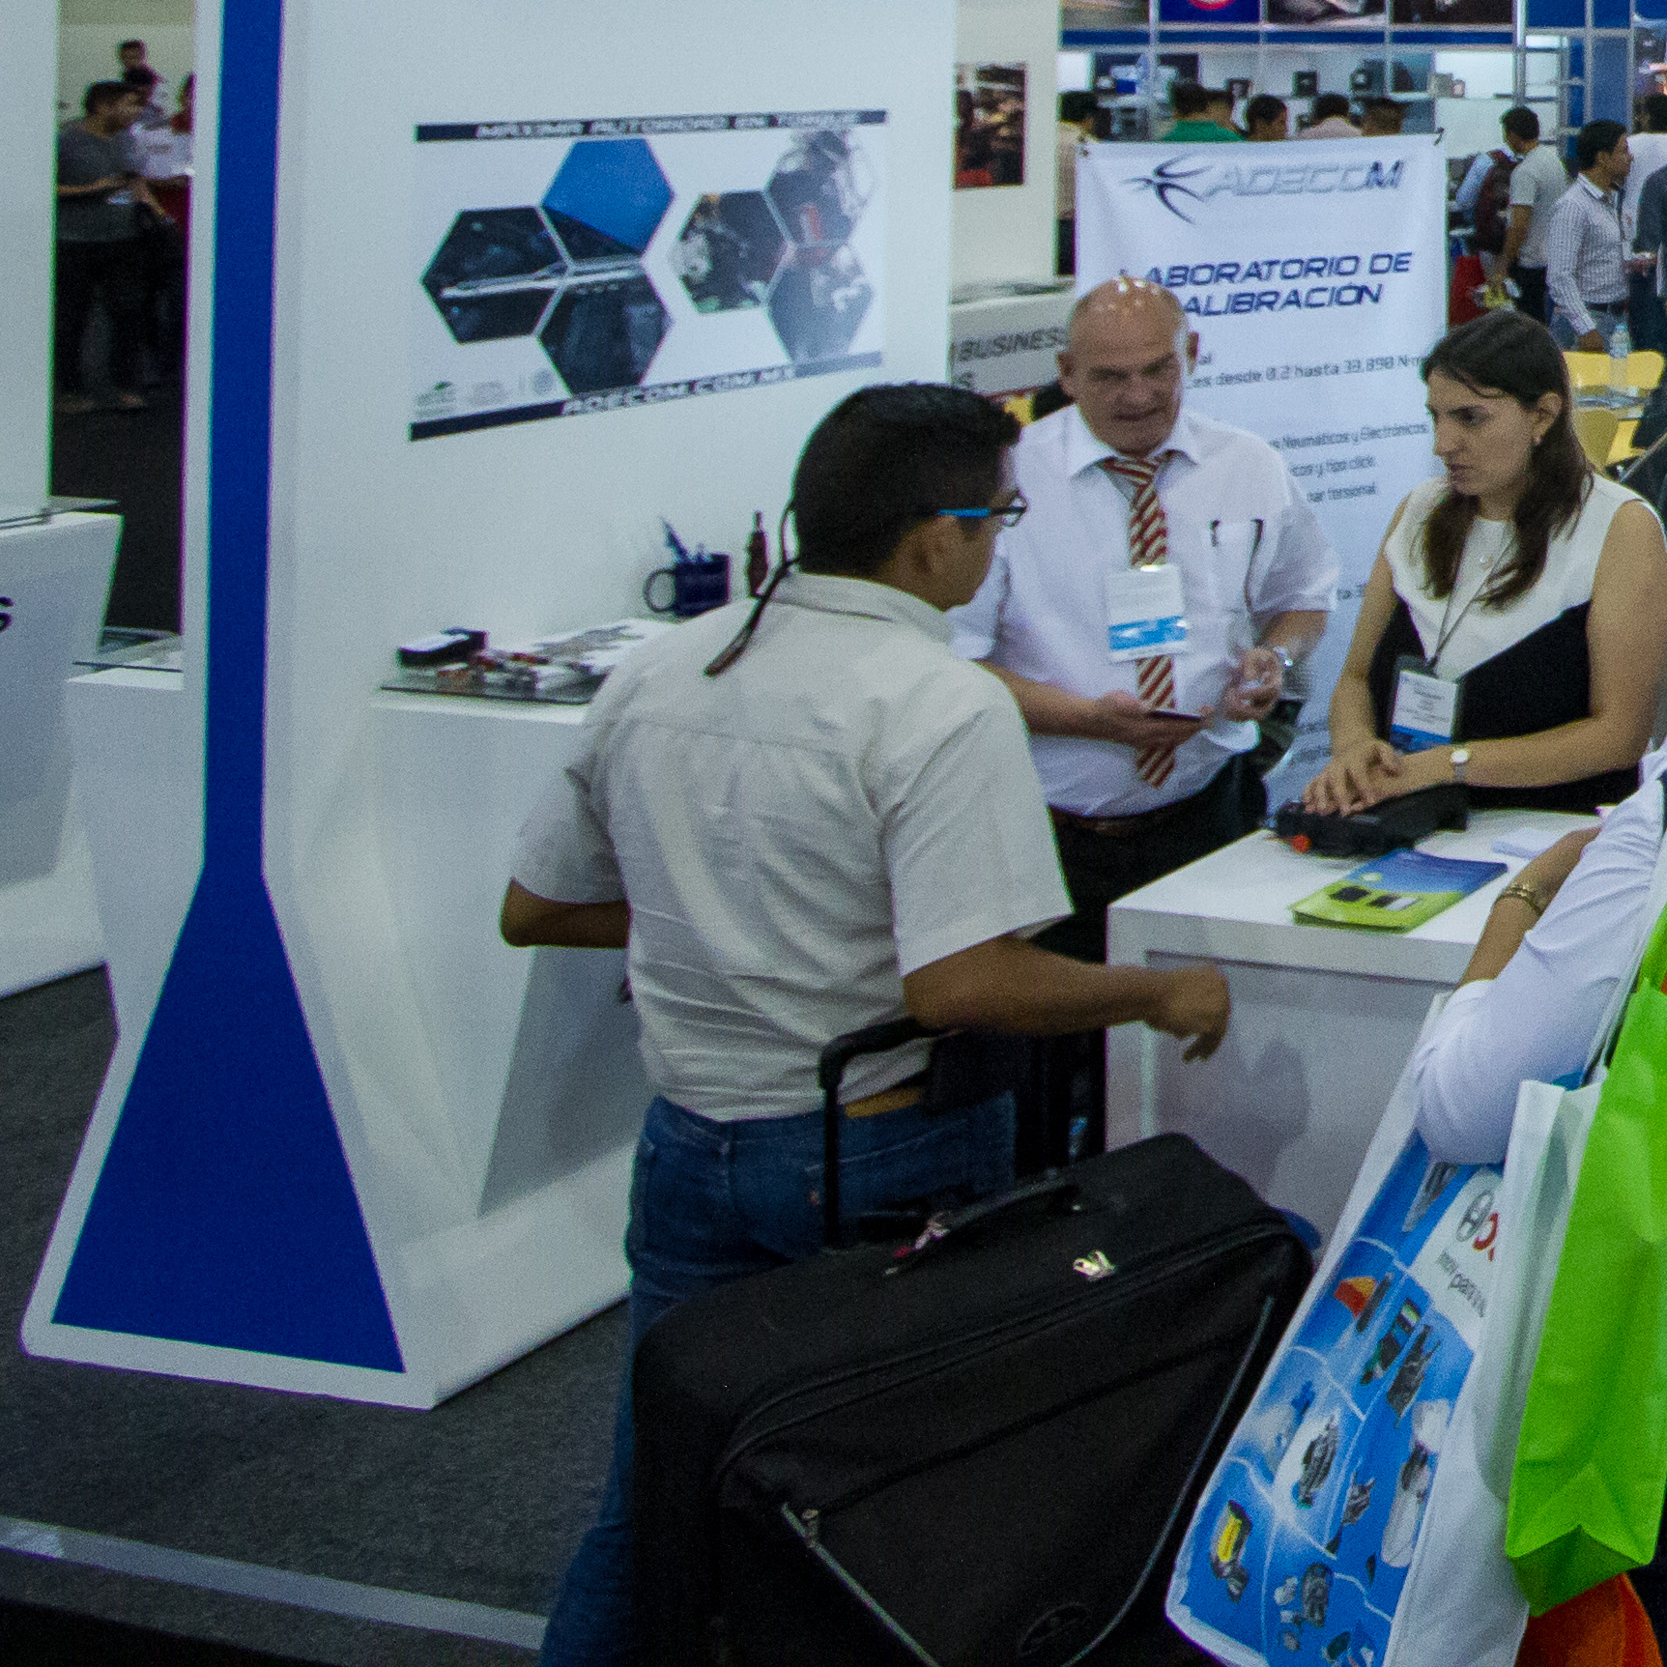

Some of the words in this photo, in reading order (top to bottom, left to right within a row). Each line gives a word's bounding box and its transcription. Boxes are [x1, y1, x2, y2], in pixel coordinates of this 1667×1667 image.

[1203, 160, 1404, 201] ADECOM
[1119, 255, 1361, 289] ABORATORIO
[1369, 252, 1413, 275] DE
[1216, 371, 1262, 386] desde
[1294, 362, 1339, 378] hasta
